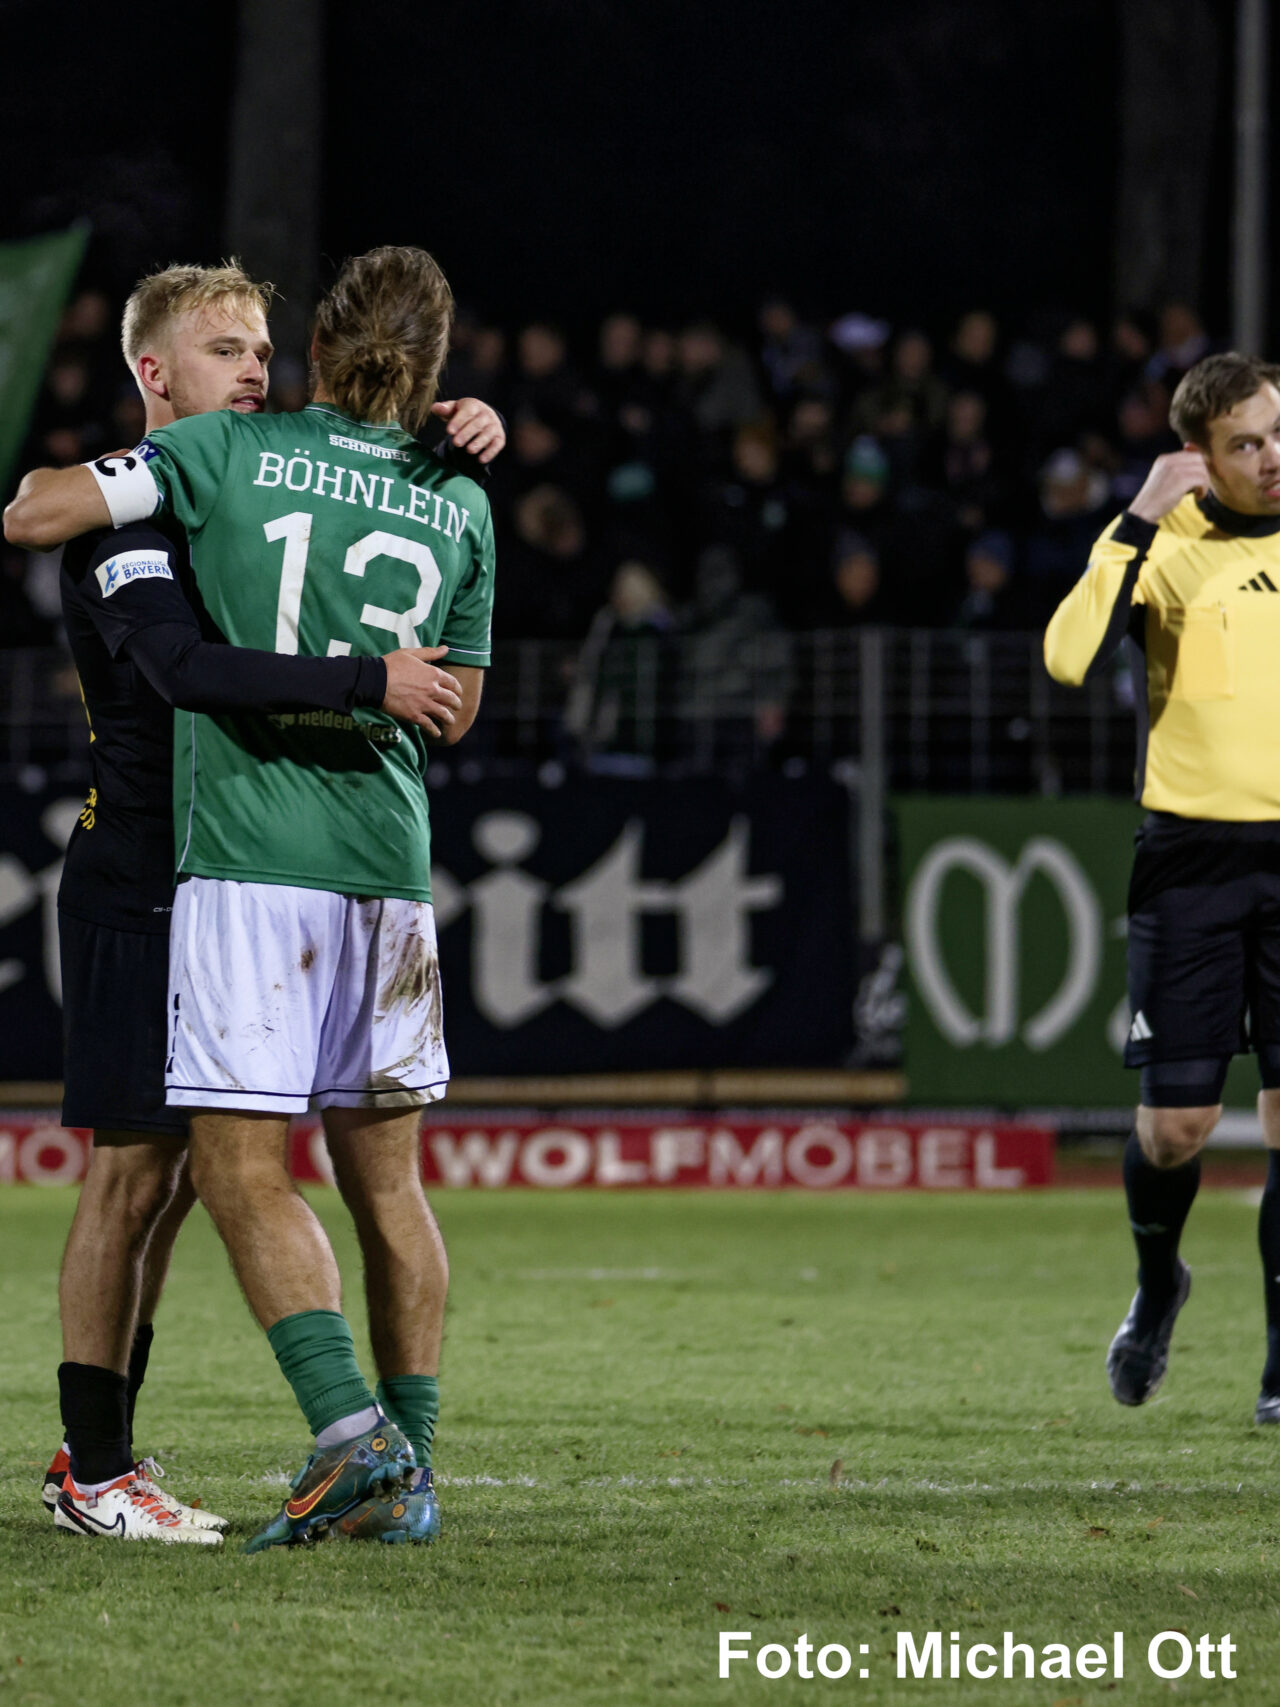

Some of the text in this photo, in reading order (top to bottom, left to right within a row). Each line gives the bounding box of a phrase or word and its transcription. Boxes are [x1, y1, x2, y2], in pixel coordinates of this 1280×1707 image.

[94, 456, 137, 477] C
[253, 448, 470, 543] BÖHNLEIN
[123, 565, 170, 579] BAYERN
[428, 1118, 1027, 1188] WOLFMÖBEL
